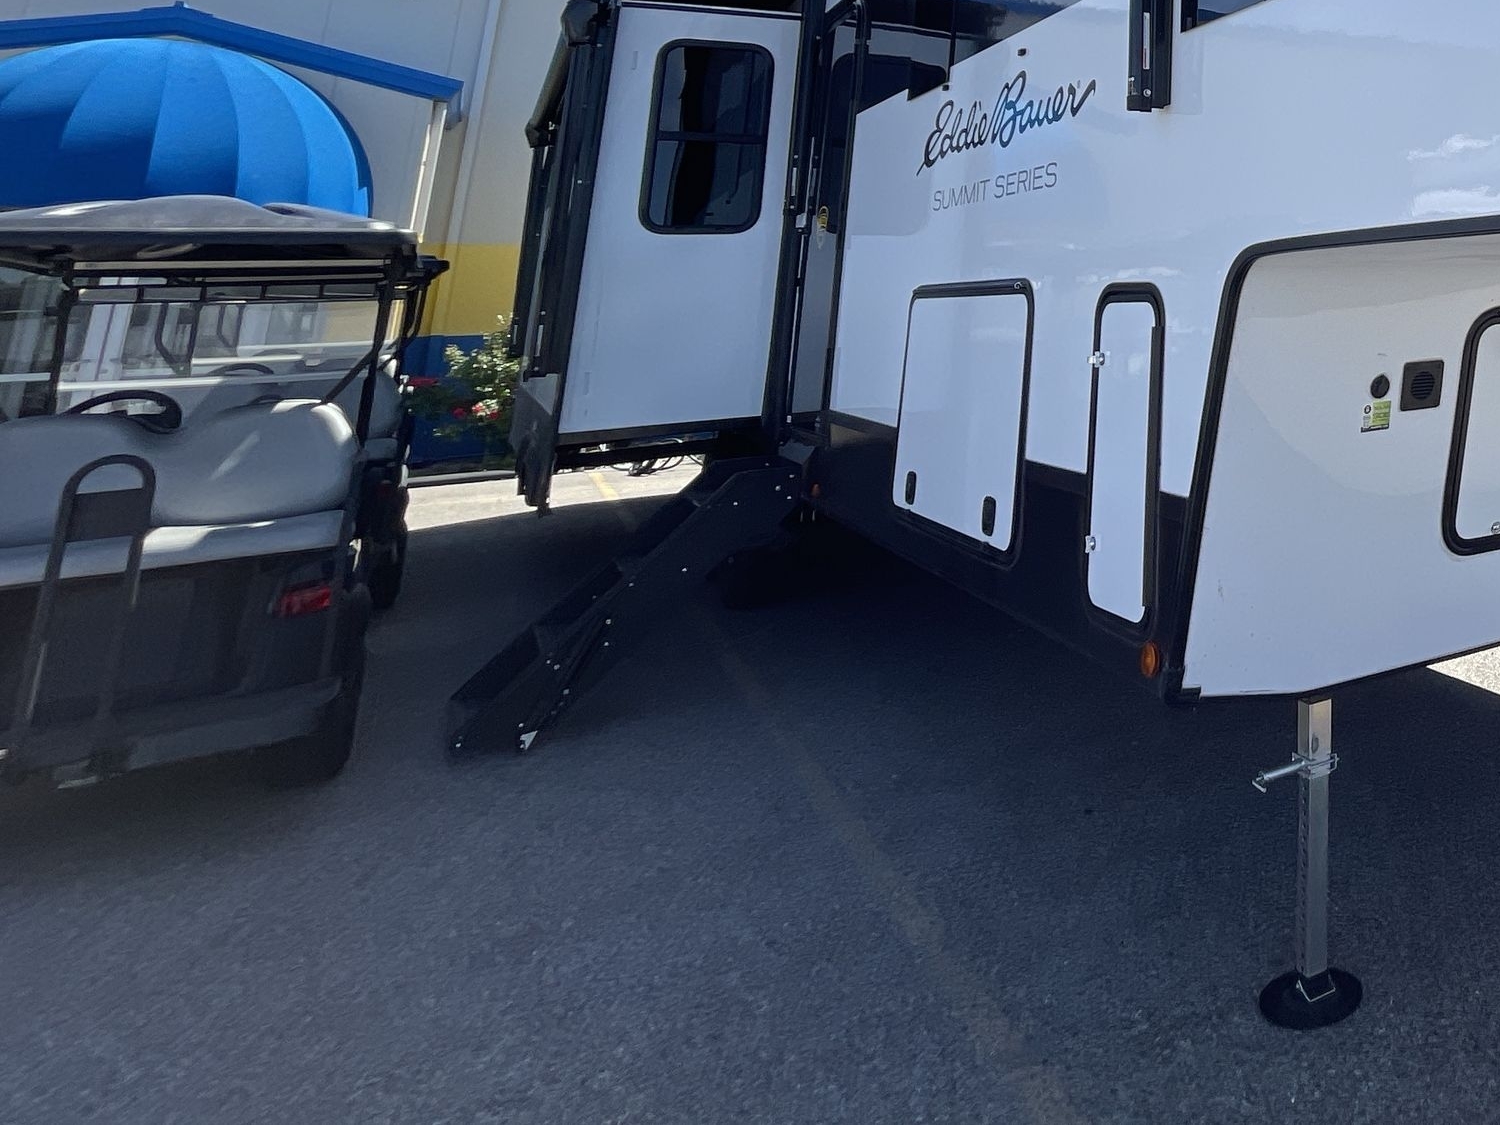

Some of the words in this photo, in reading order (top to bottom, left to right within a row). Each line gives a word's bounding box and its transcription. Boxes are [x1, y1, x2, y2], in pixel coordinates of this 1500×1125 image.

[916, 100, 989, 176] Eddie
[990, 70, 1096, 148] Bauer
[932, 179, 991, 212] SUMMIT
[993, 161, 1058, 199] SERIES
